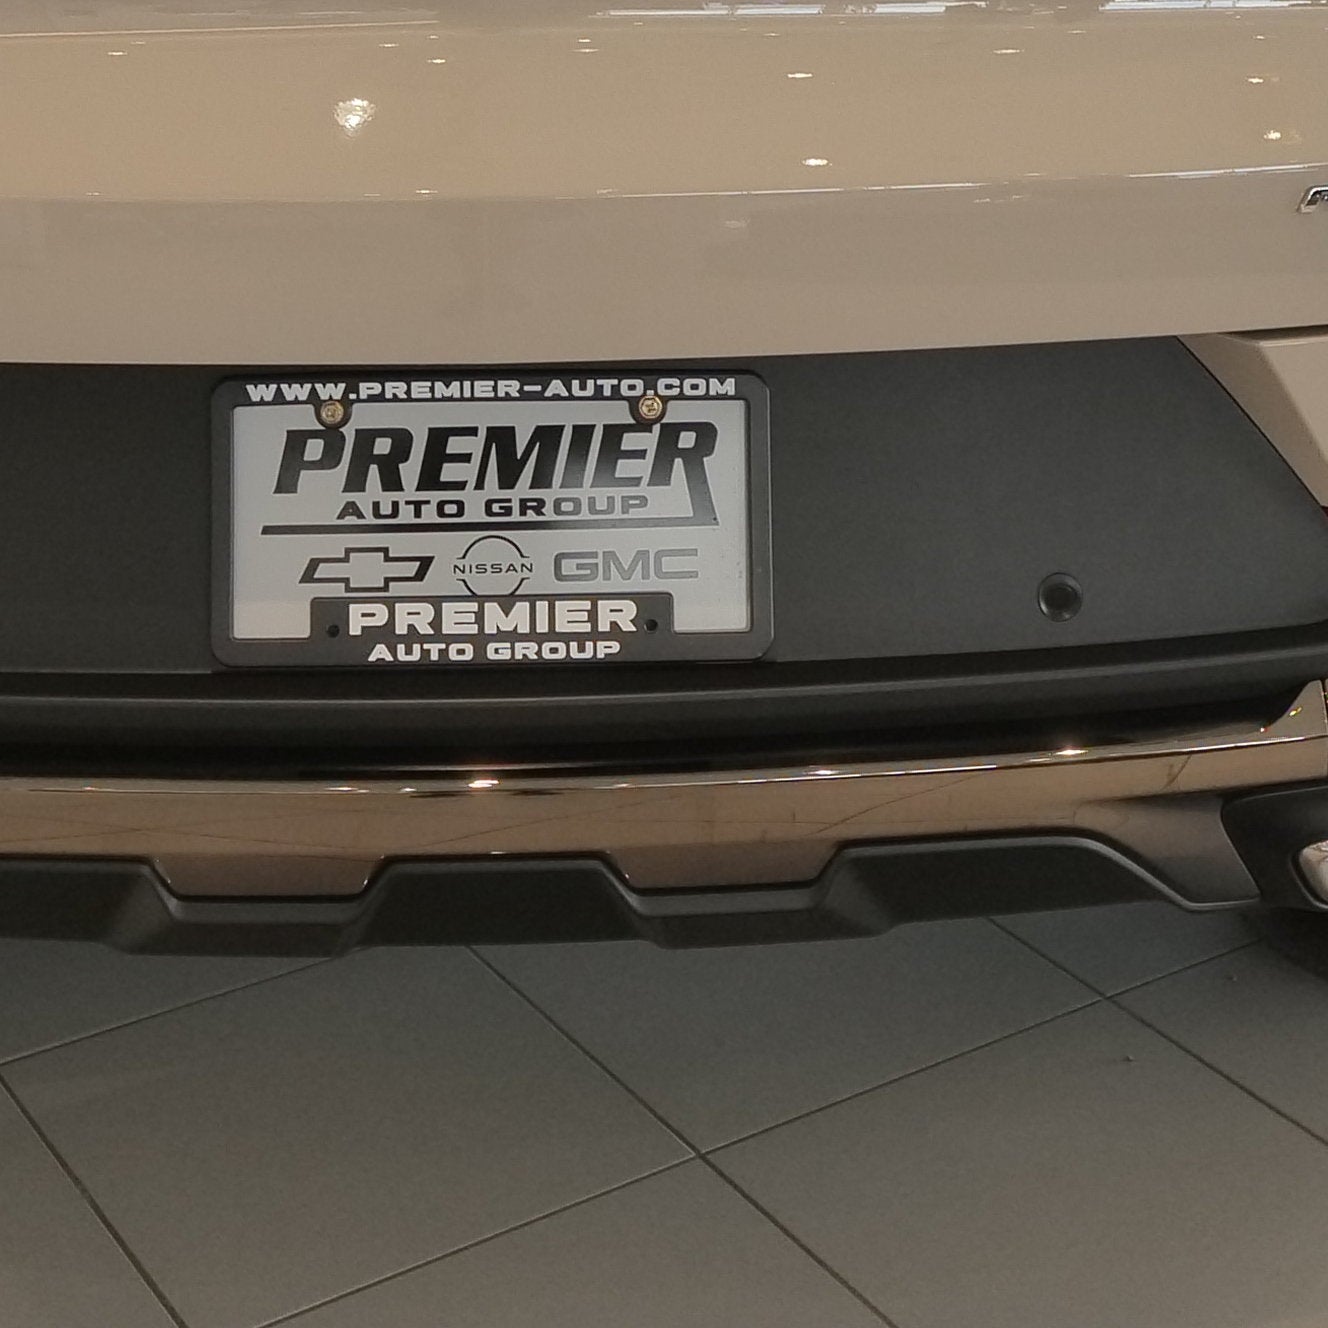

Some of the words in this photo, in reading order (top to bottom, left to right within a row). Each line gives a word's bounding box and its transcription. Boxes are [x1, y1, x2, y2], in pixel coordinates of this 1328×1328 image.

[246, 377, 736, 402] WWW.PREMIER-AUTO.COM
[272, 421, 719, 502] PREMIER
[336, 497, 465, 521] AUTO
[484, 494, 649, 518] GROUP
[453, 561, 534, 575] NISSAN
[553, 548, 700, 583] GMC
[348, 599, 638, 636] PREMIER
[368, 642, 474, 663] AUTO
[485, 640, 621, 661] GROUP
